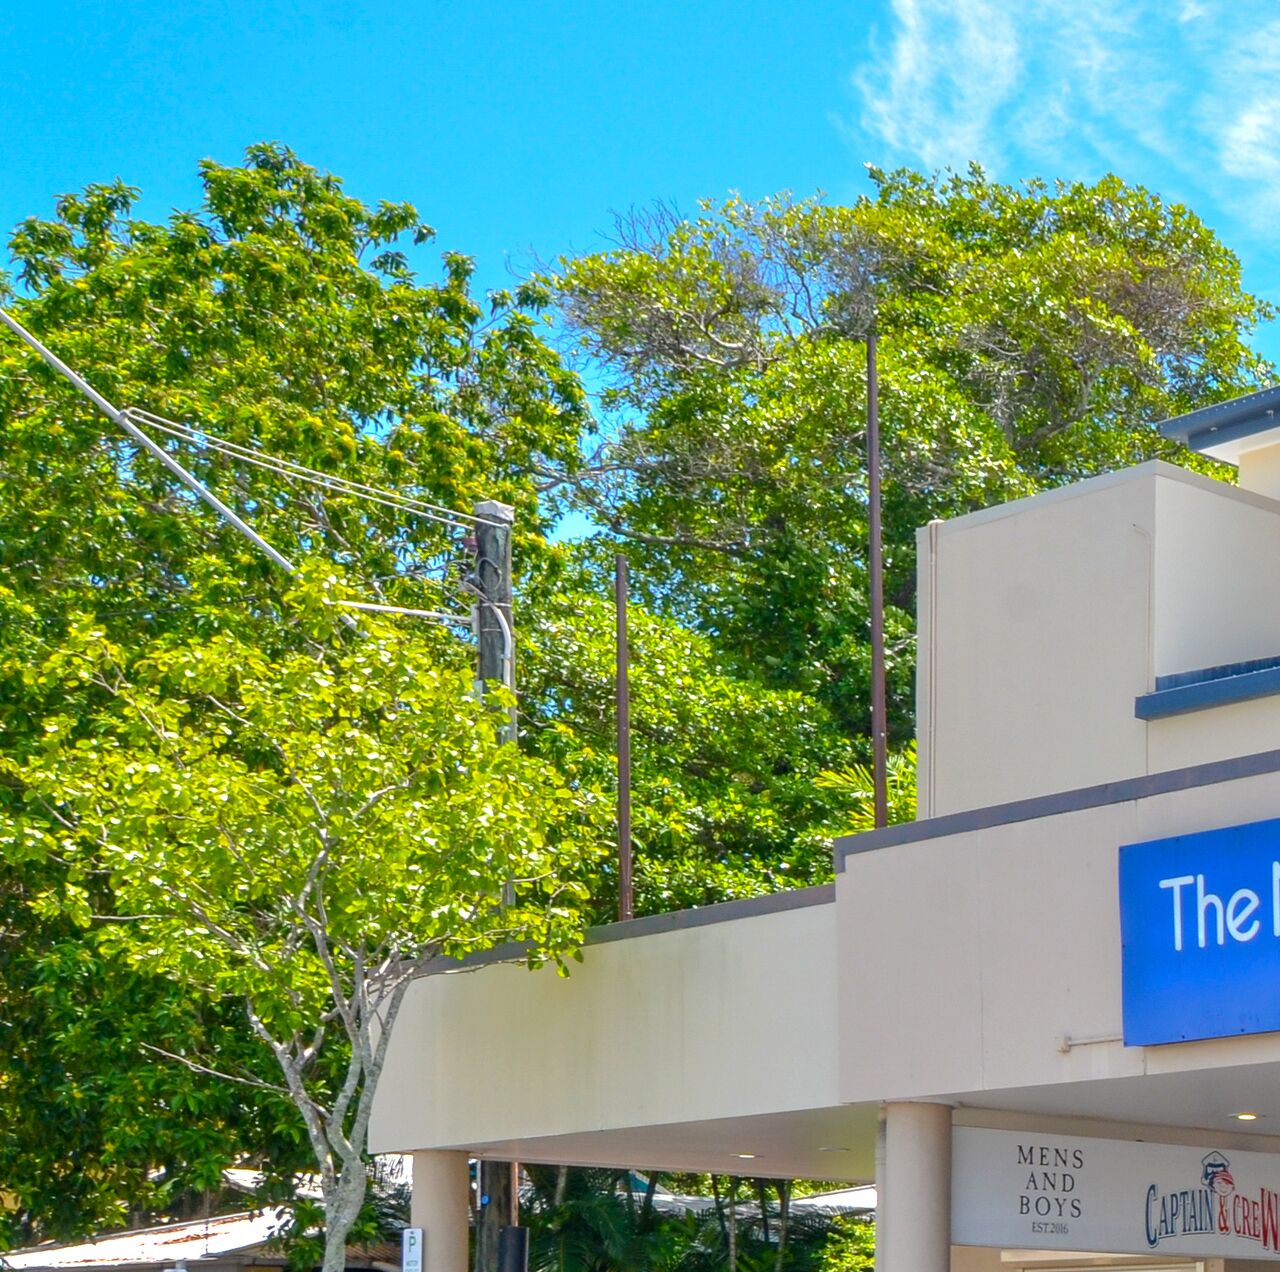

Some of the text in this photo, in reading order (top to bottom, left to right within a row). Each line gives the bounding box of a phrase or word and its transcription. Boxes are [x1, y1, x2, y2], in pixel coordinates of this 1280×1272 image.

[1158, 874, 1260, 951] The
[1017, 1145, 1084, 1169] MENS
[1026, 1170, 1075, 1192] AND
[1019, 1195, 1081, 1218] BOYS
[1145, 1184, 1280, 1253] CAPTAIN & CREW
